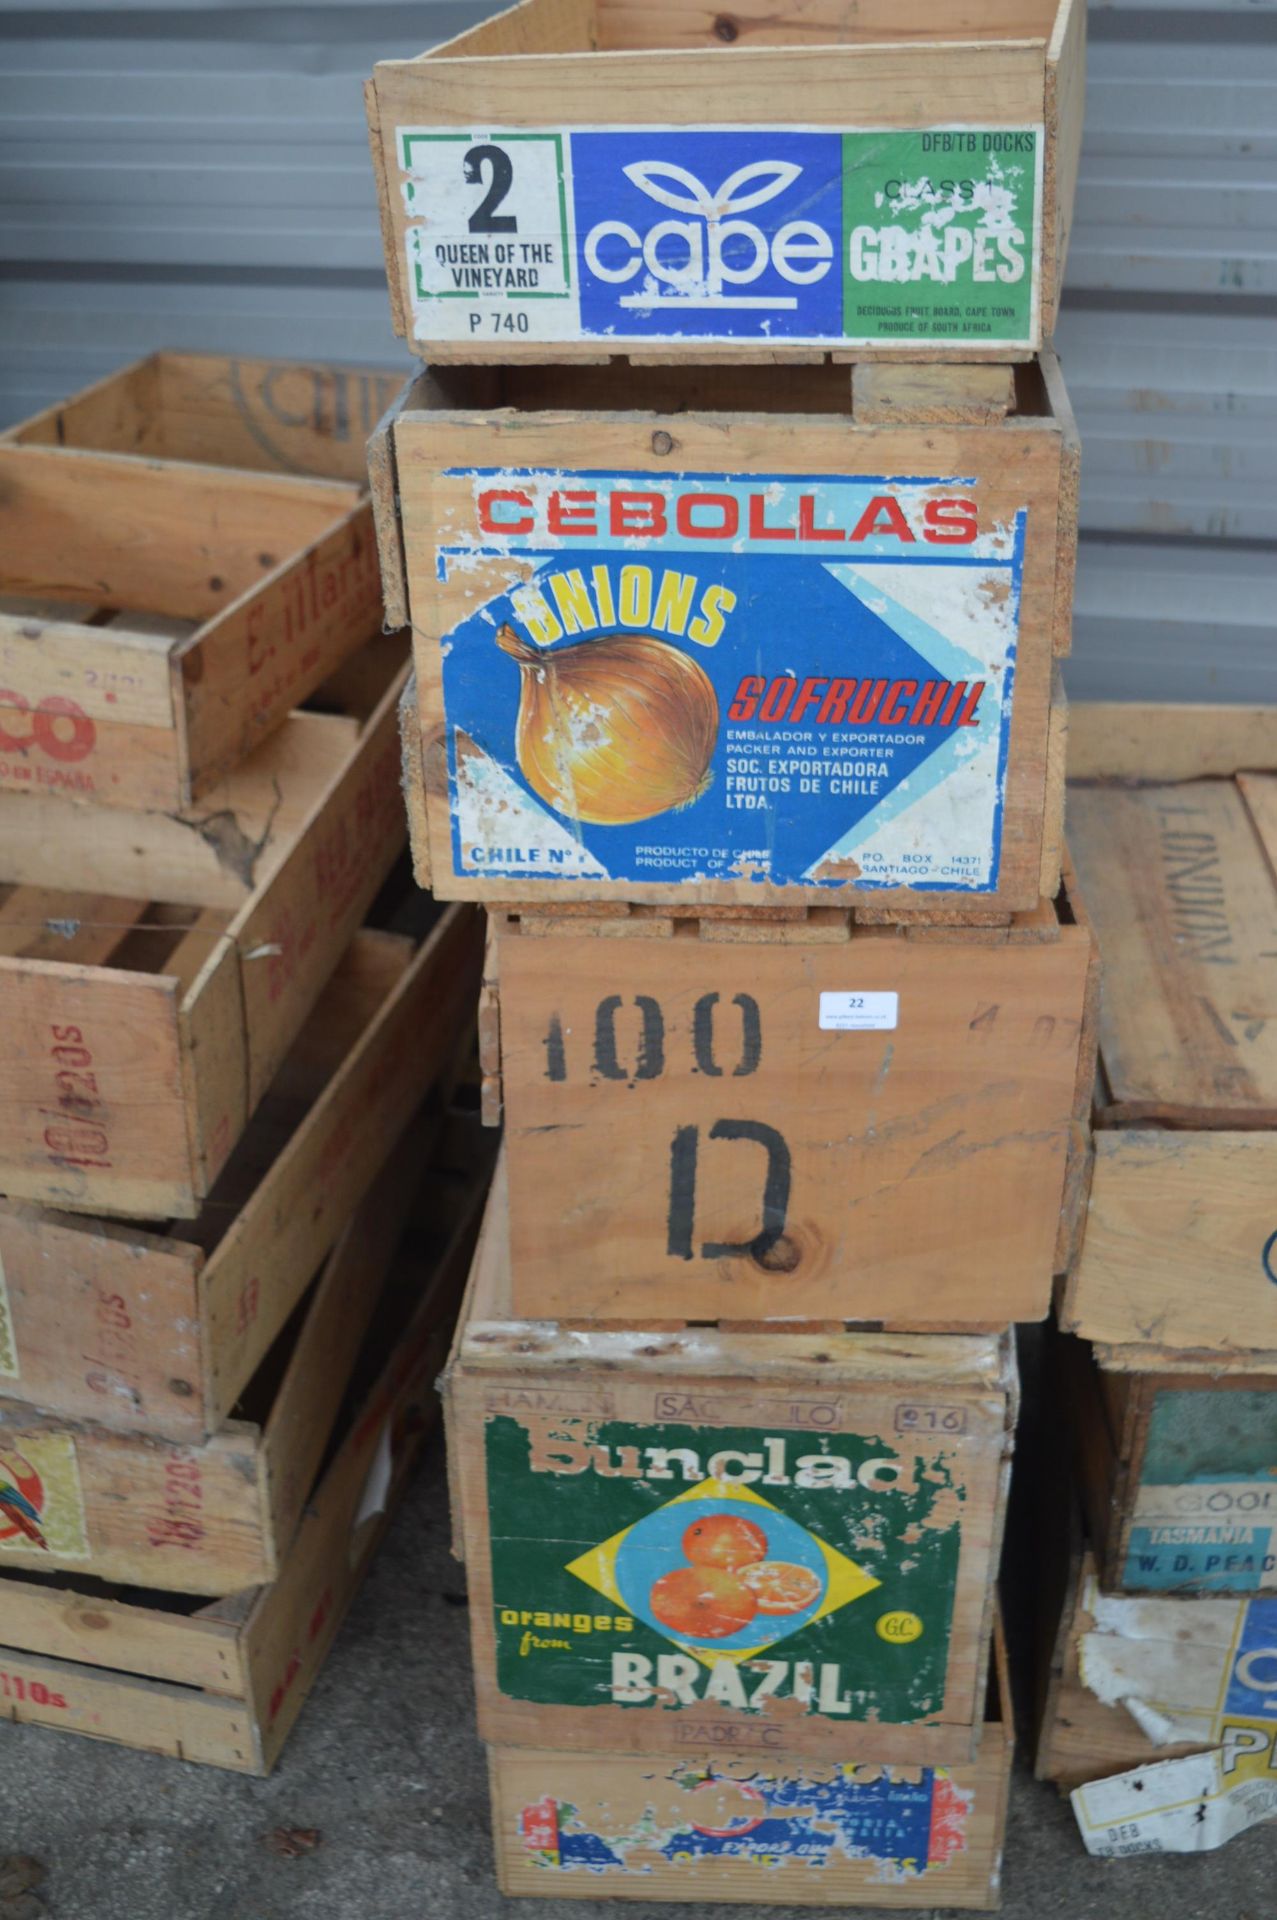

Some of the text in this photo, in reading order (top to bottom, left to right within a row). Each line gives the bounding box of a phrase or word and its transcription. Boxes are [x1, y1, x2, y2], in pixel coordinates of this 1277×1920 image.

[922, 133, 1033, 152] DFB/TB DOCKS
[463, 145, 518, 233] 2
[884, 179, 975, 199] CLASS
[435, 244, 553, 267] QUEEN OF THE
[584, 220, 833, 297] cape
[850, 225, 1025, 284] GRAPES
[452, 268, 539, 288] VINEYARD
[966, 307, 987, 317] CAPE
[992, 307, 1015, 317] TOWN
[469, 312, 529, 332] P 740
[878, 322, 991, 333] PRODUCE OF SOUTH AFRICA
[478, 488, 978, 546] CEBOLLAS
[727, 676, 986, 728] SOFRUCHIL
[726, 730, 926, 745] EMBALADOR Y EXPORTADOR
[726, 745, 894, 759] PACKER AND EXPORTER
[726, 760, 888, 778] SOC. EXPORTADORA
[726, 777, 879, 795] FRUTOS DE CHILE
[726, 794, 773, 810] LTDA.
[471, 847, 539, 864] CHILE
[635, 845, 707, 858] PRODUCTO
[711, 849, 729, 859] DE
[902, 853, 932, 864] BOX
[635, 857, 698, 869] PRODUCT
[707, 860, 725, 870] OF
[862, 864, 981, 877] SANTIAGO CHILE
[849, 998, 864, 1008] 22
[543, 991, 762, 1082] 100
[1150, 1527, 1254, 1545] TASMANIA
[1137, 1555, 1161, 1572] W.
[1173, 1555, 1194, 1572] D.
[501, 1610, 634, 1633] oranges
[519, 1631, 573, 1657] from
[612, 1652, 852, 1714] BRAZIL
